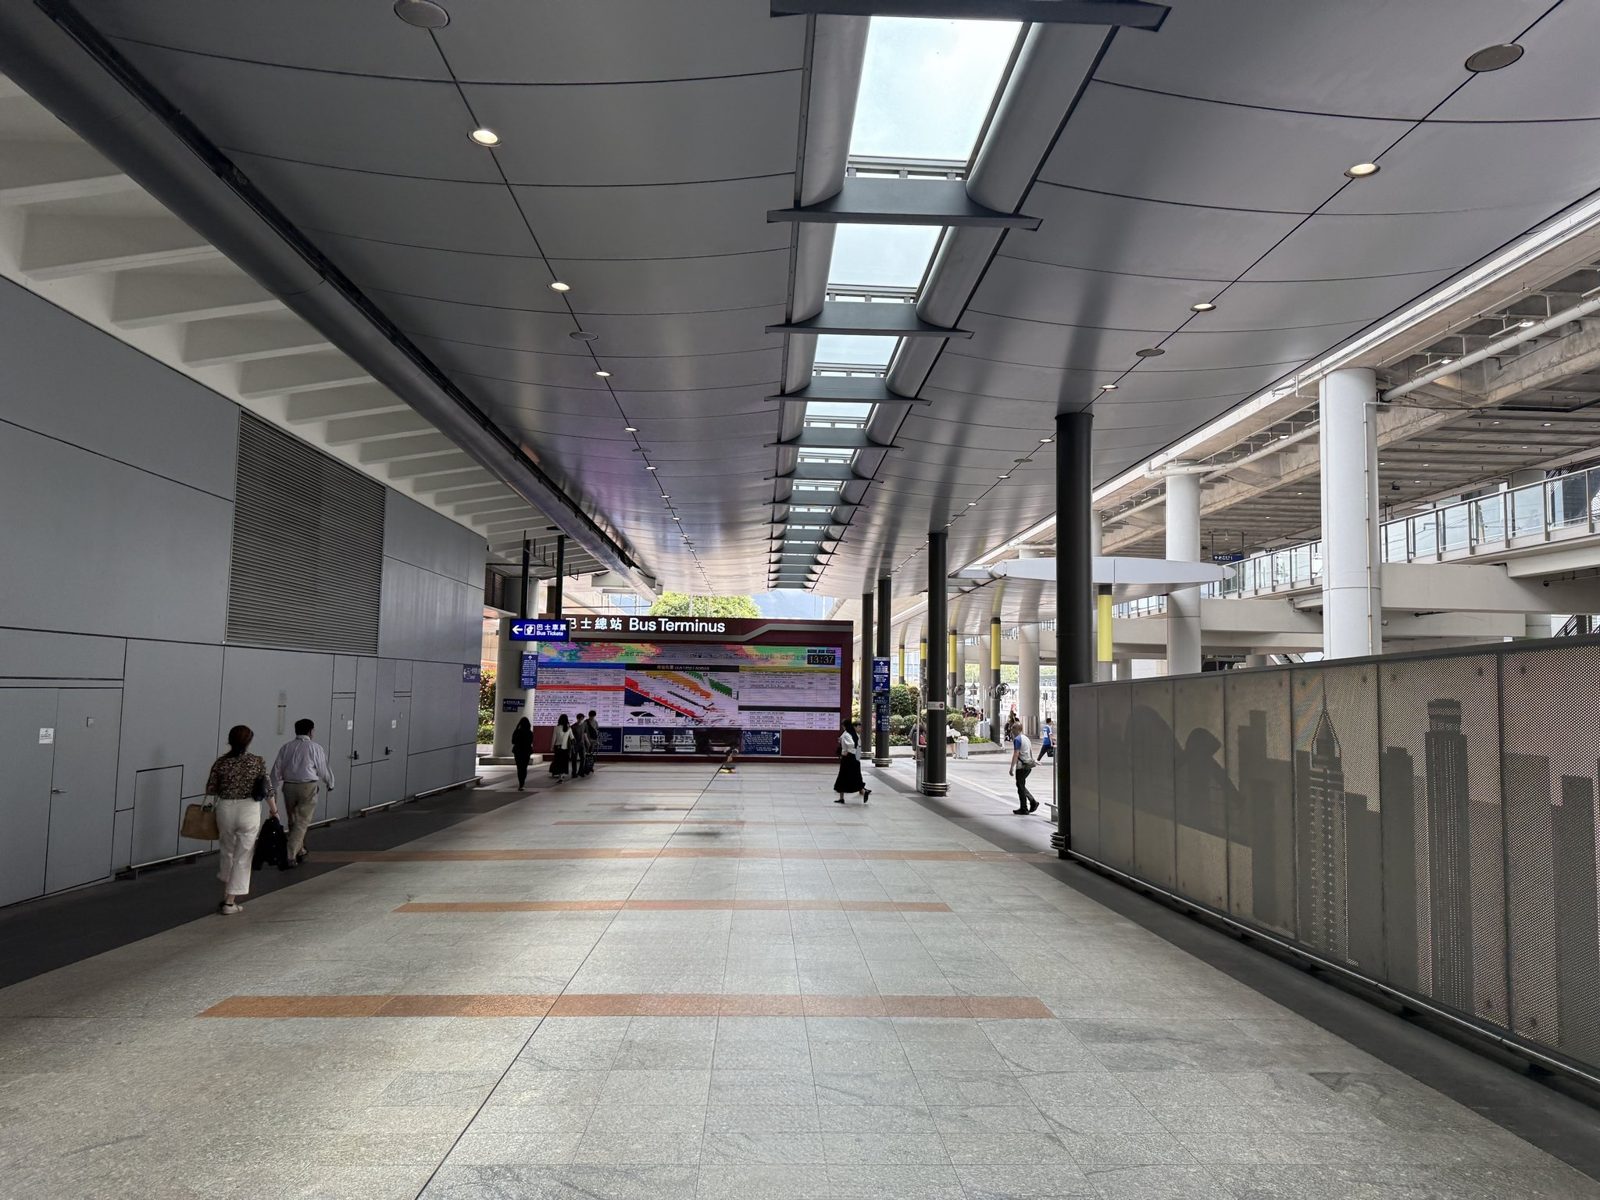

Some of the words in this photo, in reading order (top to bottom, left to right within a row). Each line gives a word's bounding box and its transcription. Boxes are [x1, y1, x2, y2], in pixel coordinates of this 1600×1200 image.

[565, 617, 622, 630] 巴士總站
[629, 617, 657, 631] Bus
[658, 618, 726, 633] Terminus
[810, 655, 834, 664] 13:37
